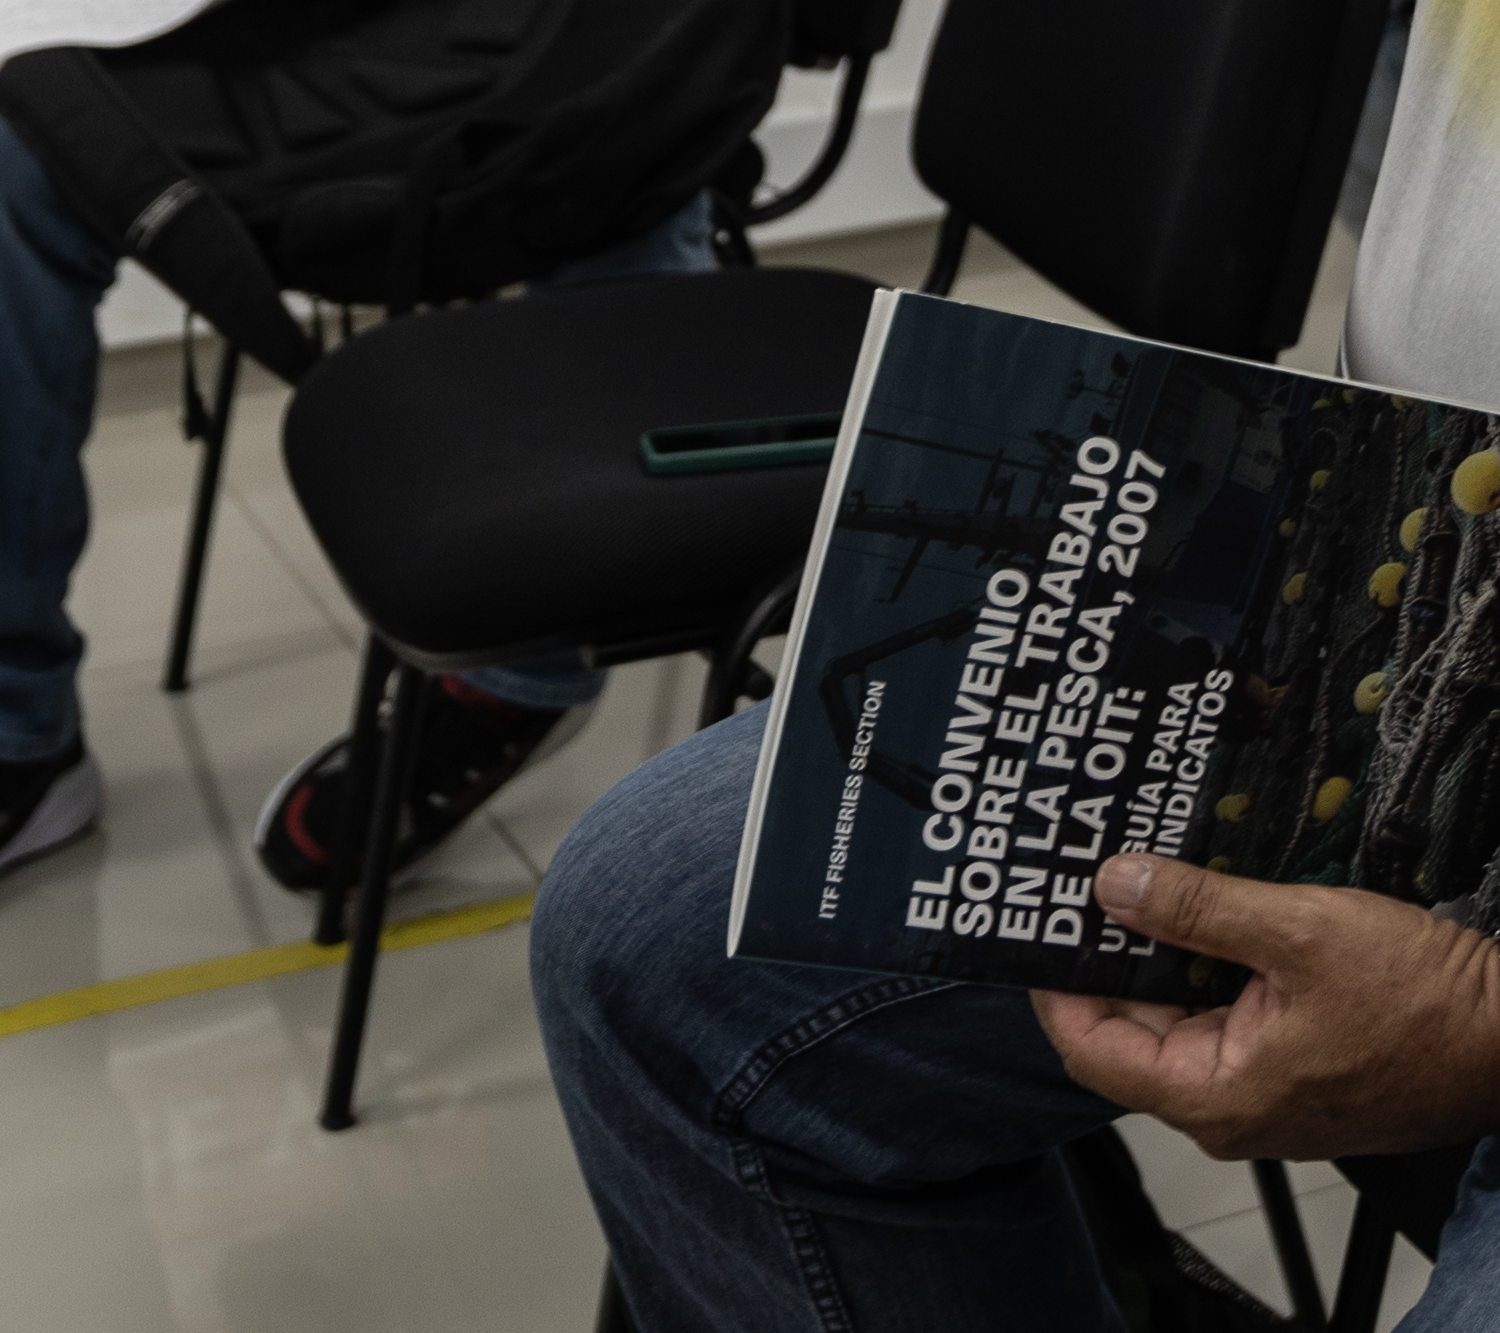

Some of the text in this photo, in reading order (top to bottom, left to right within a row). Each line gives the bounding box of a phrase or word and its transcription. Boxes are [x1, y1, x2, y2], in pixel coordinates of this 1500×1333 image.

[905, 567, 1031, 930] EL CONVENIO
[952, 435, 1122, 938] SOBRE EL TRABAJO
[997, 449, 1167, 942] EN LA PESCA, 2007
[1083, 686, 1147, 782] OIT:
[1145, 681, 1199, 772] PARA
[1152, 668, 1234, 856] INDICATOS
[818, 680, 887, 919] ITF FISHERIES SECTION
[1060, 794, 1116, 861] LA
[1041, 873, 1094, 947] DE
